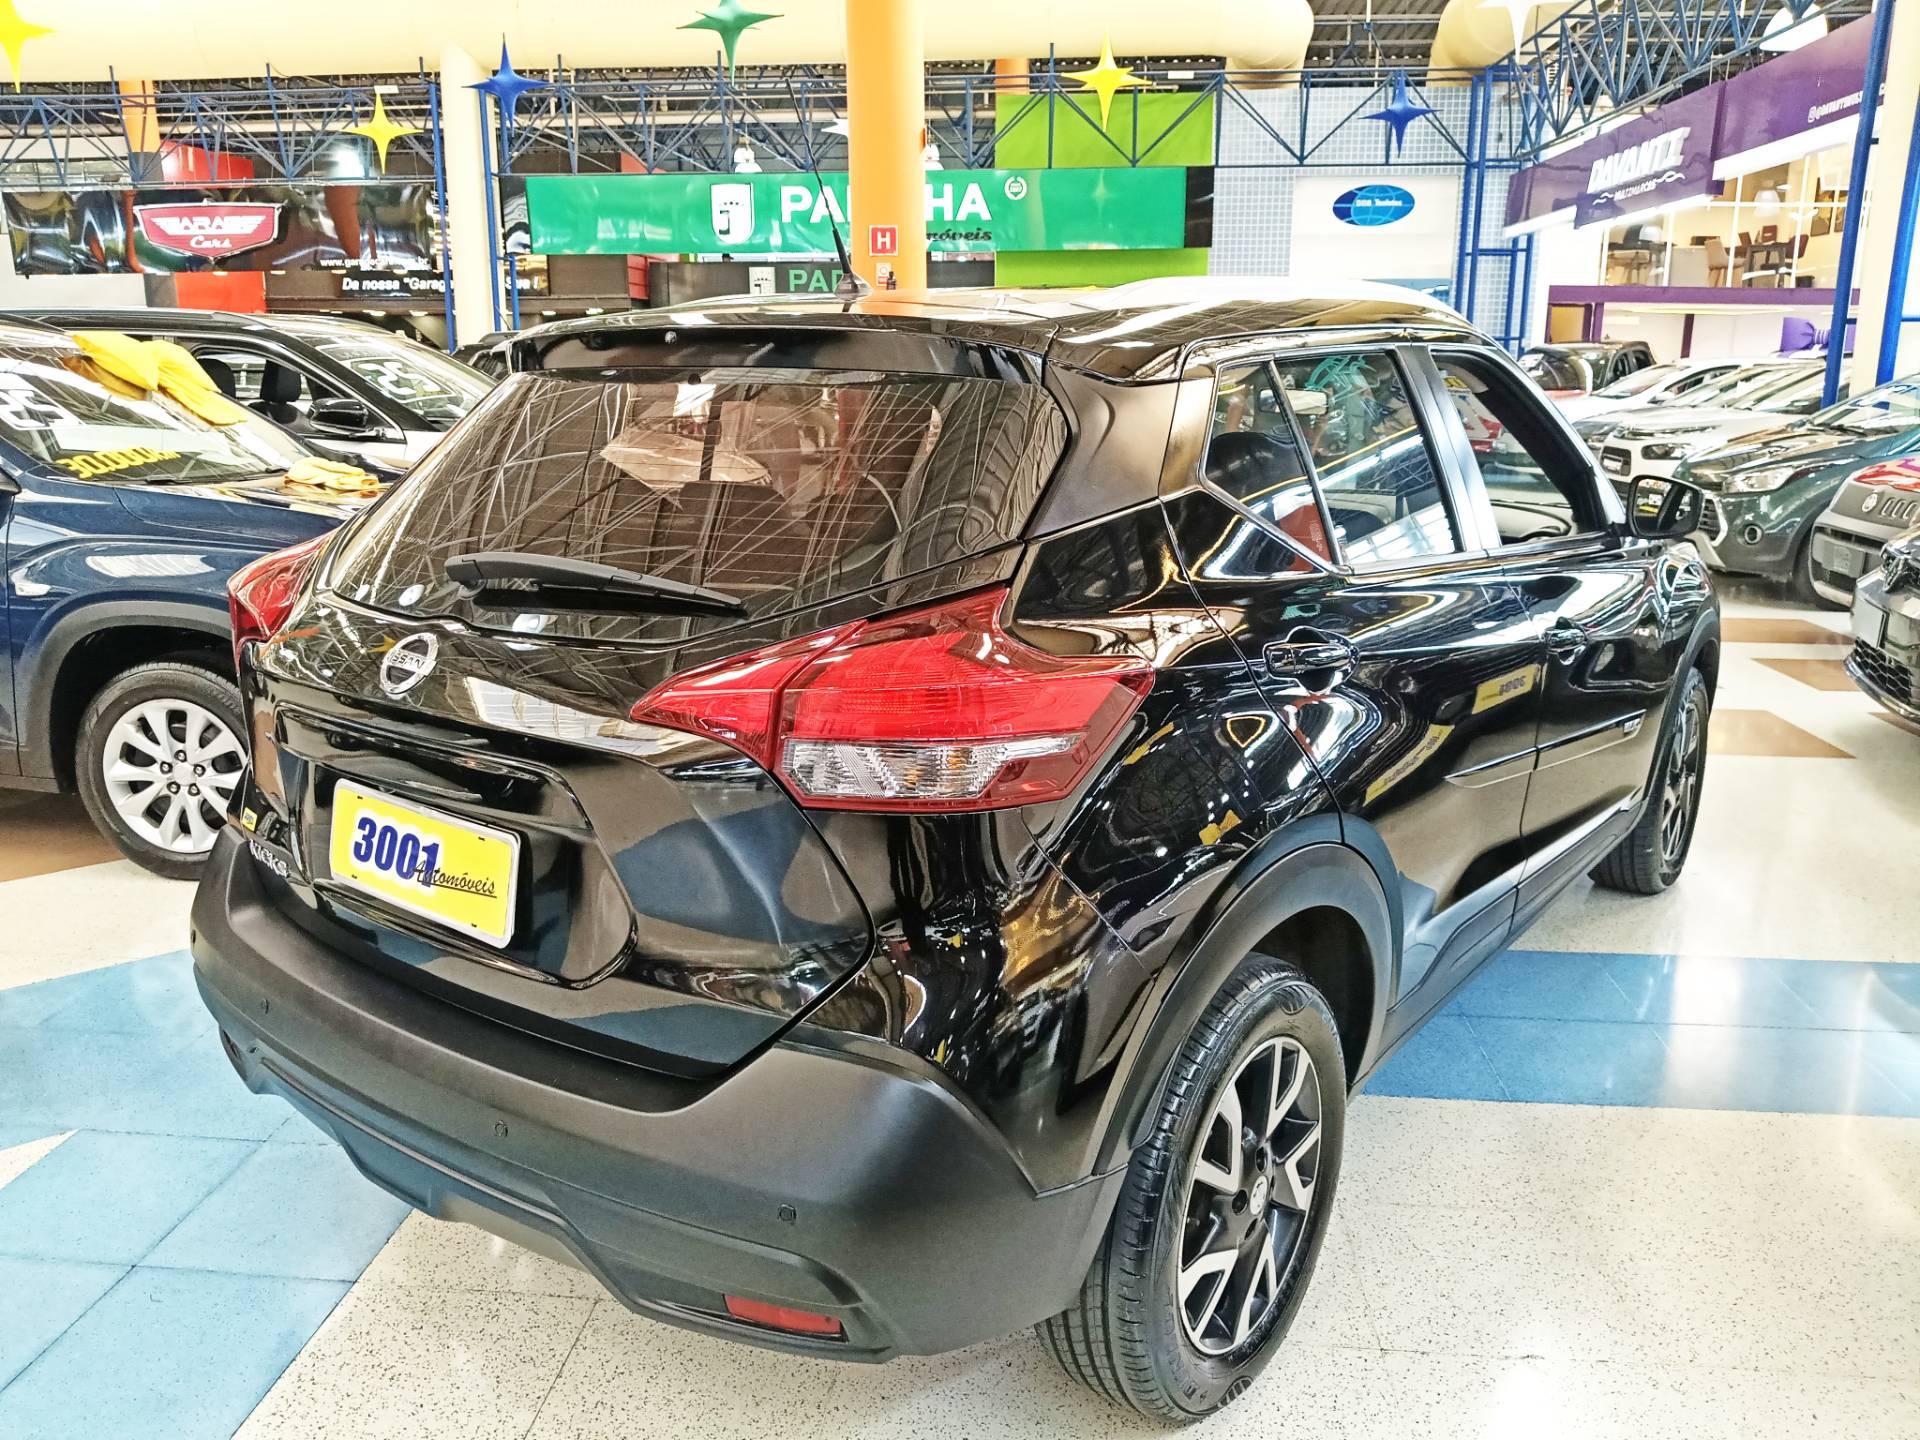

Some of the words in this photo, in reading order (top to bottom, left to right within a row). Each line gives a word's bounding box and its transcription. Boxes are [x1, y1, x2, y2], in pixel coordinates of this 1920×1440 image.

[1587, 126, 1691, 194] DAVANTI
[780, 182, 992, 223] PAHA
[190, 236, 233, 248] Cars
[877, 231, 891, 250] H
[362, 279, 400, 290] nossa
[403, 277, 455, 293] "Garag
[353, 816, 440, 888] 3001
[412, 859, 497, 896] Automóveis
